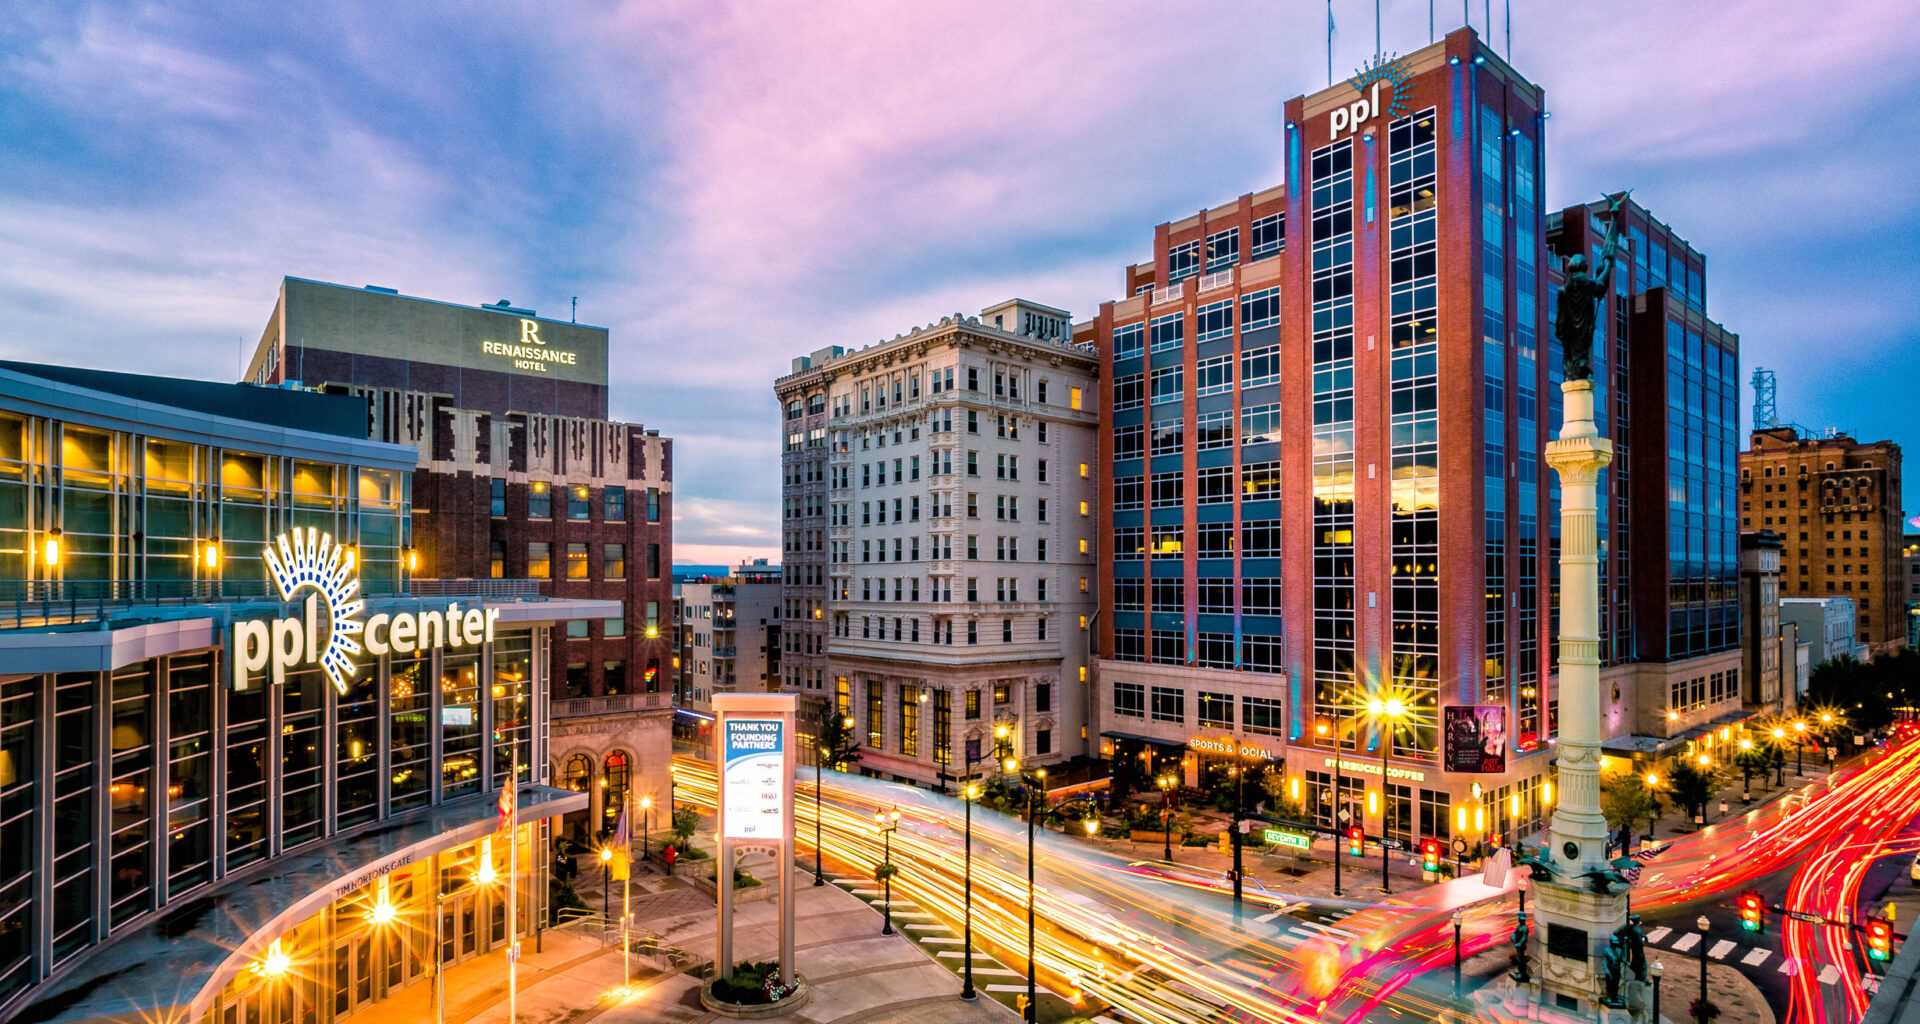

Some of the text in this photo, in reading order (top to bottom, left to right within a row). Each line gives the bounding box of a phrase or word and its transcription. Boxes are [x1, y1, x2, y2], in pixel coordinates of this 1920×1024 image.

[1330, 81, 1379, 140] ppl
[520, 318, 546, 345] R
[483, 341, 576, 365] RENAISSANCE
[515, 359, 546, 372] HOTEL
[234, 592, 499, 691] ppl center
[729, 723, 779, 731] THANK YOU
[731, 733, 777, 742] FOUNDING
[732, 741, 776, 749] PARTNERS
[1190, 739, 1224, 752] SPORTS
[1226, 744, 1233, 753] &
[1483, 758, 1499, 766] ART
[1324, 758, 1424, 781] STARBUCKS COFFEE
[1267, 832, 1296, 844] SEVENTH
[336, 855, 411, 897] TIM HORTONS GATE
